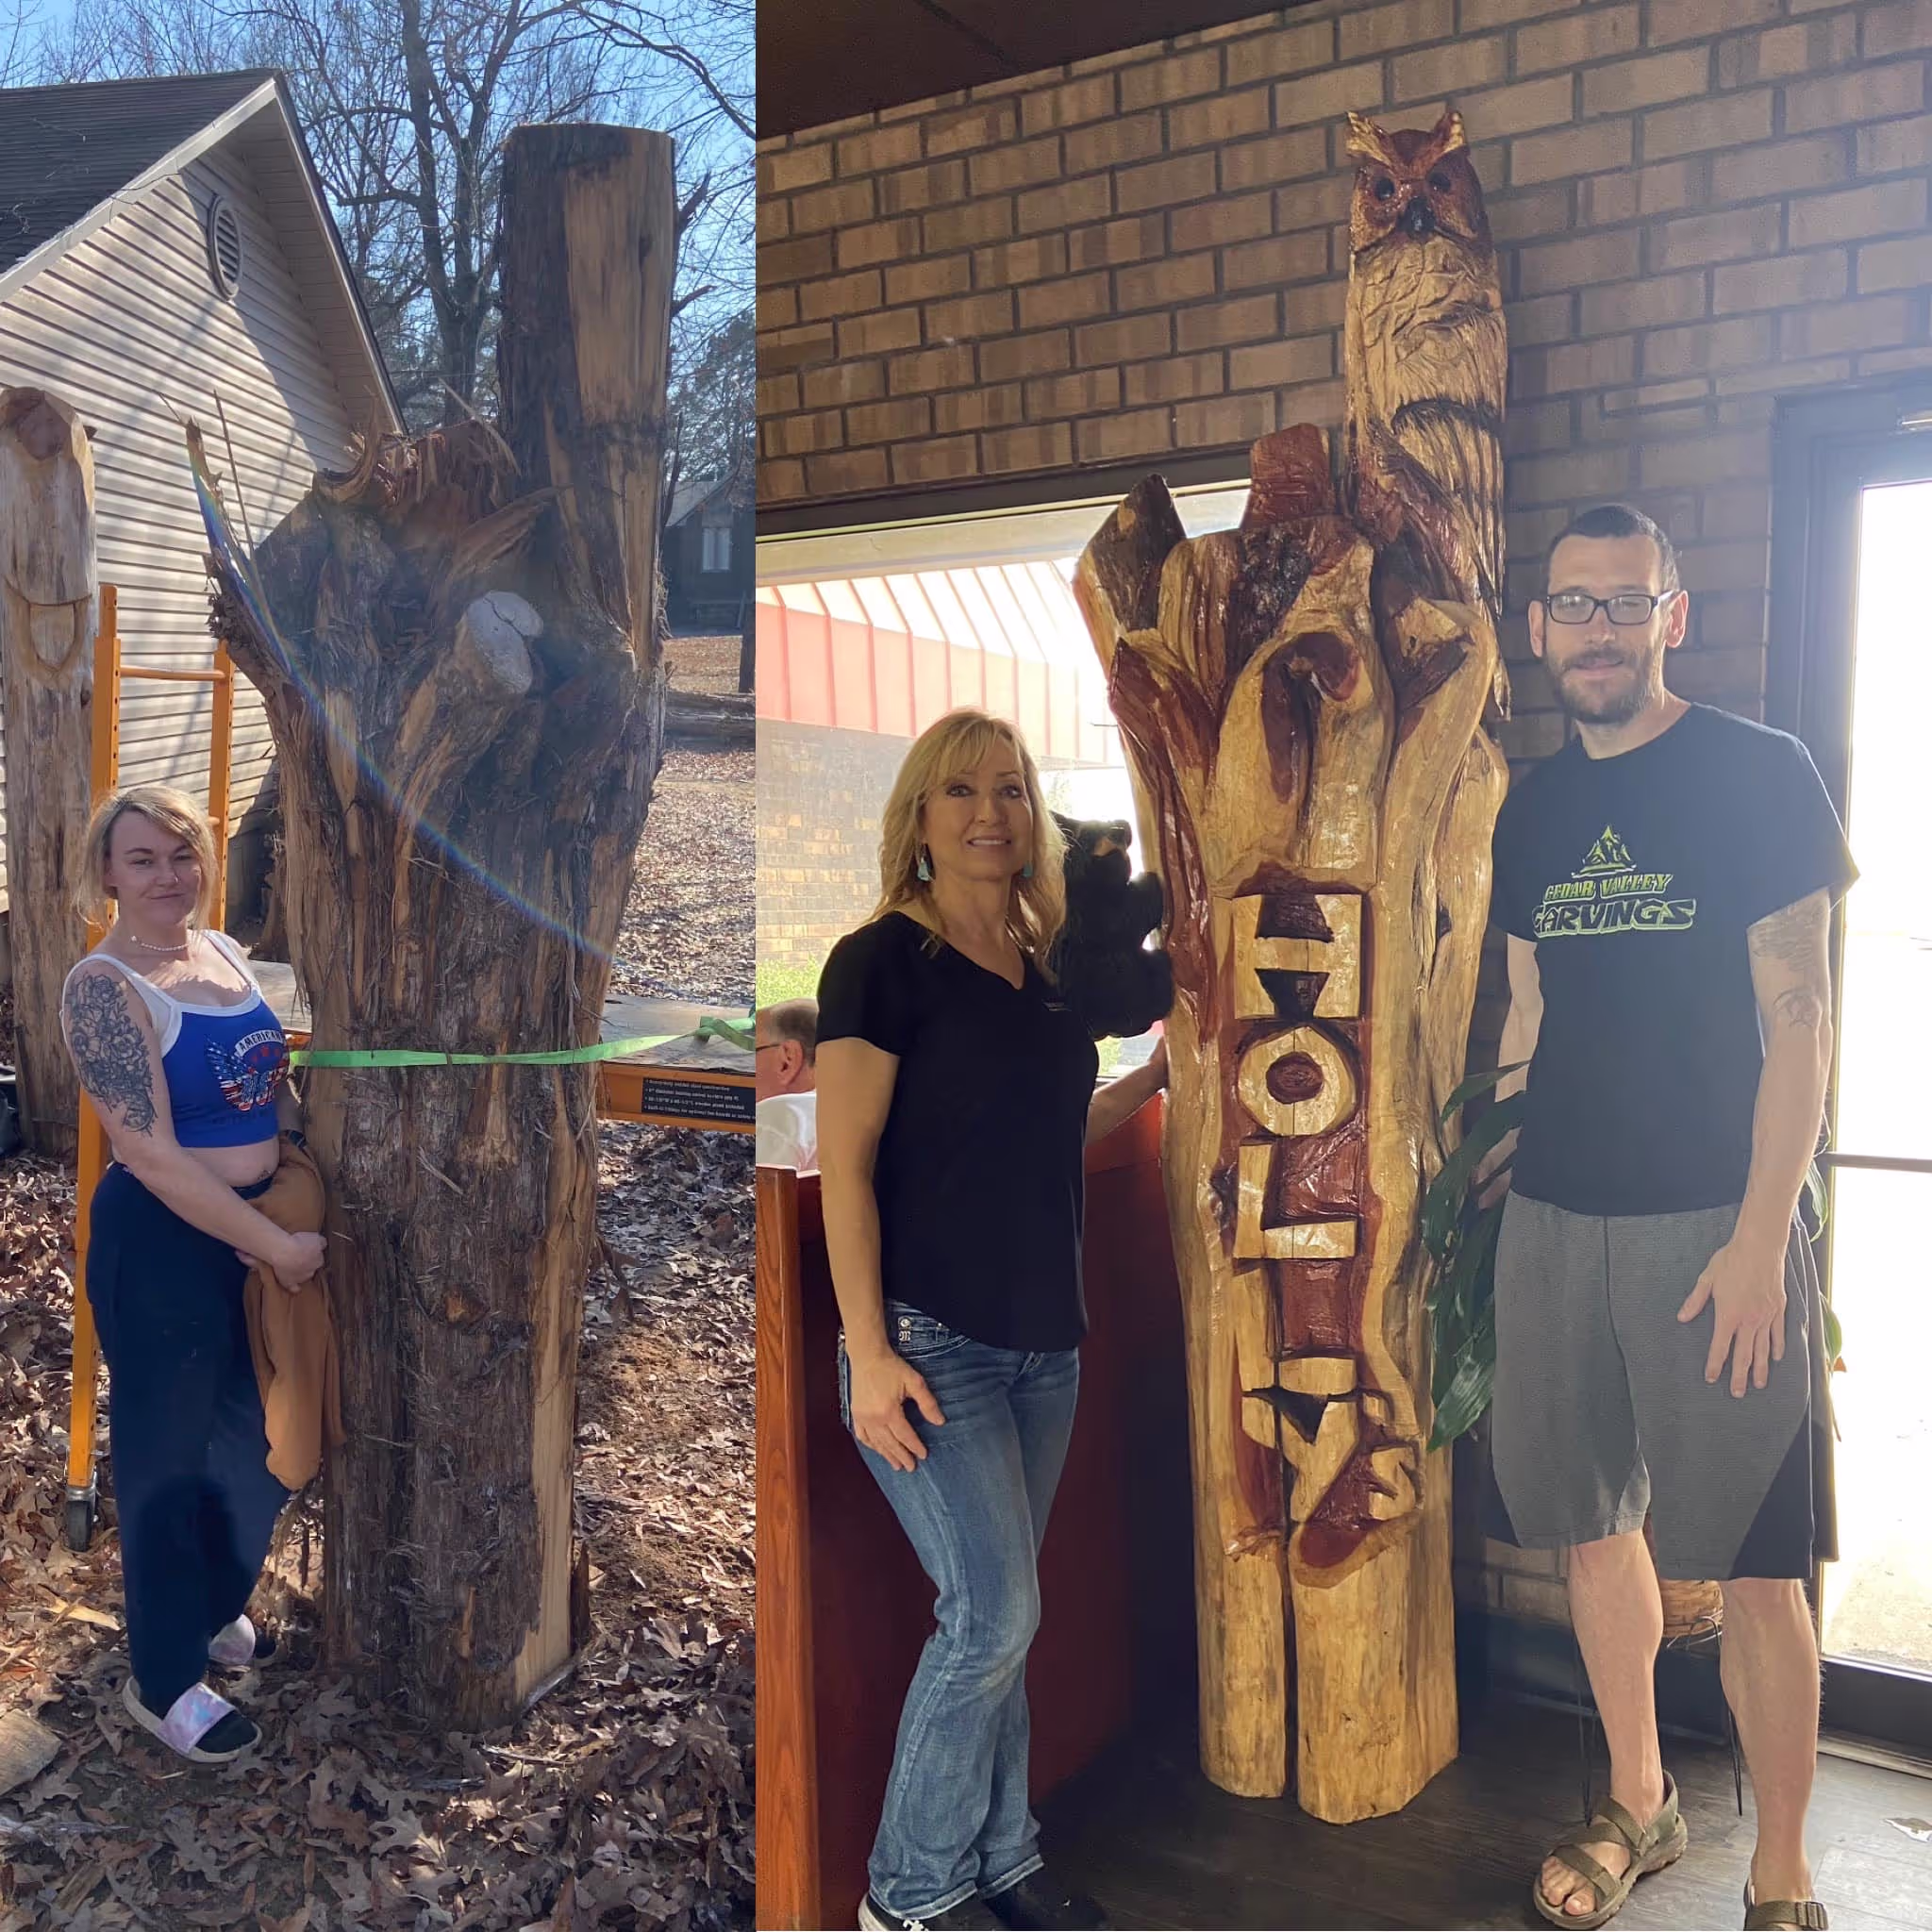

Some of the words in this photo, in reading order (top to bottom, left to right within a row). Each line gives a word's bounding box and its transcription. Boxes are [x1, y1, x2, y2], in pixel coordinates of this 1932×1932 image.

[1544, 880, 1596, 904] CEDAR
[1600, 874, 1674, 899] VALLEY
[1532, 898, 1697, 939] CARVINGS
